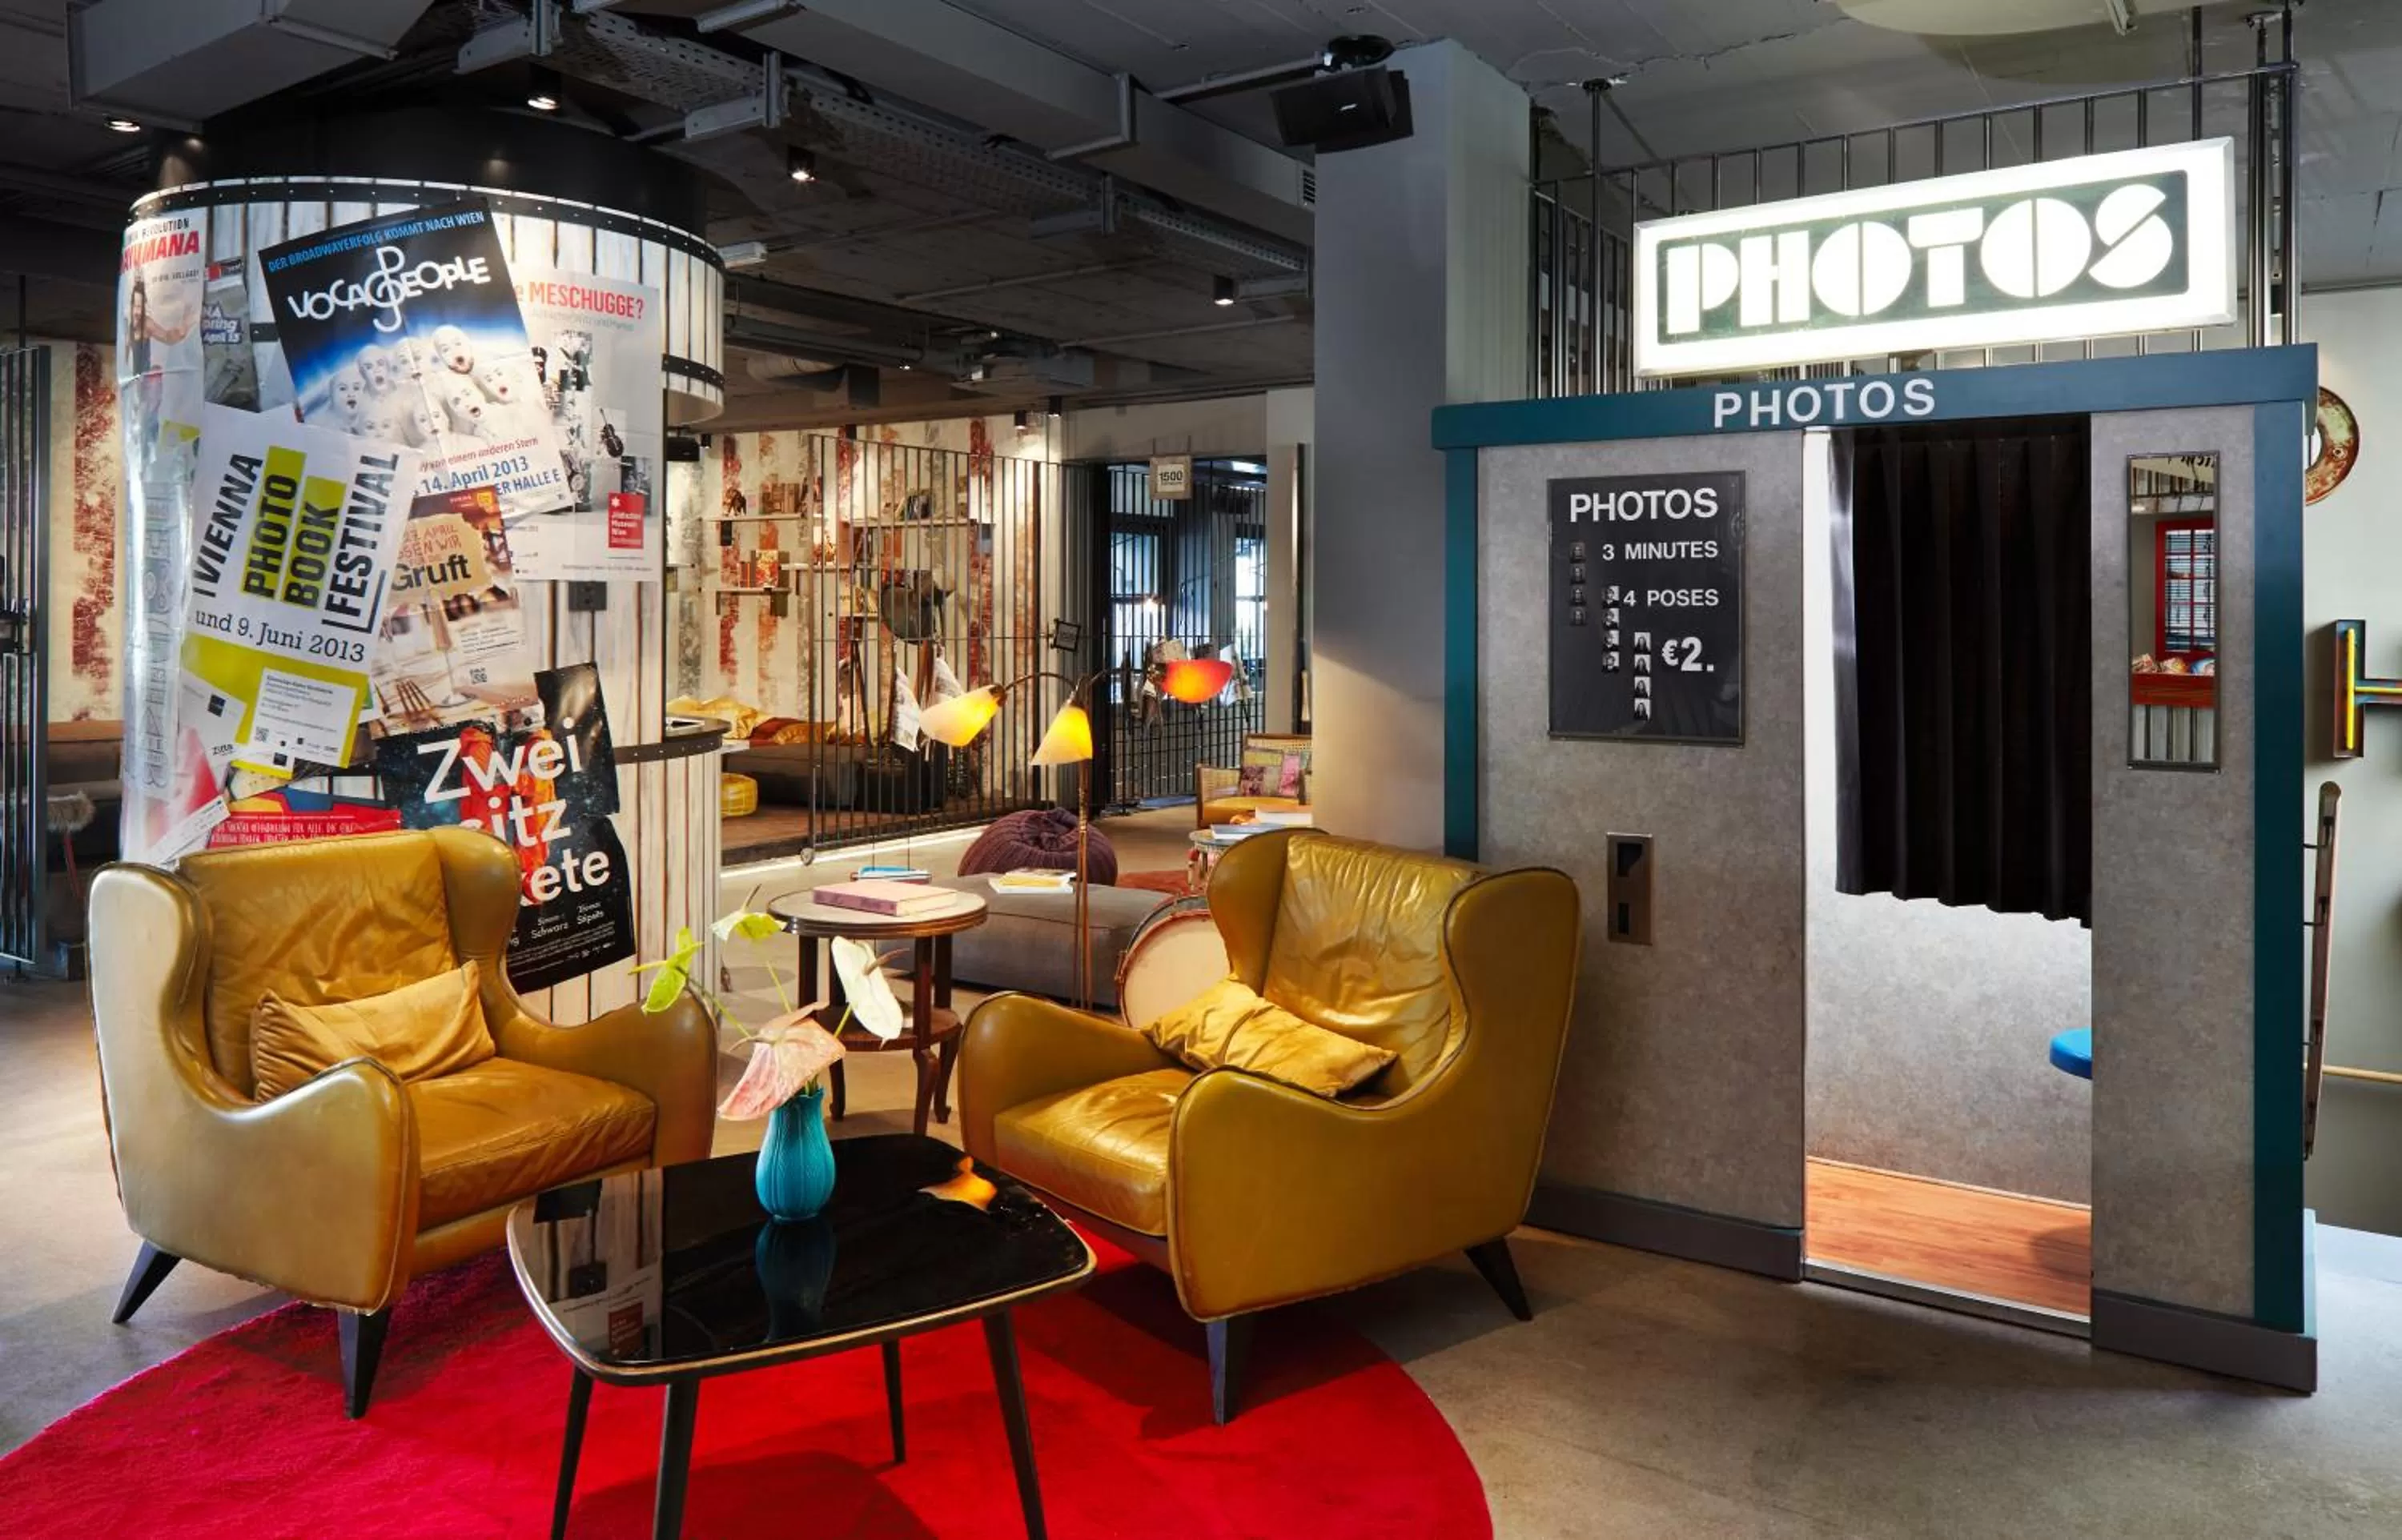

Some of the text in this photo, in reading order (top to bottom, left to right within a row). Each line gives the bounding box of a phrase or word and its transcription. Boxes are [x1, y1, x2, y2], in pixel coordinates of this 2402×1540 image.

[268, 256, 288, 272] DER
[384, 221, 424, 240] KOMMT
[426, 213, 455, 233] NACH
[456, 211, 485, 228] WIEN
[1666, 183, 2173, 335] PHOTOS
[528, 281, 645, 319] MESCHUGGE?
[1713, 378, 1936, 429] PHOTOS
[420, 475, 448, 494] 14.
[452, 463, 488, 488] April
[492, 455, 529, 478] 2013
[514, 471, 549, 491] HALLE
[553, 468, 561, 481] E
[1159, 470, 1183, 481] 1500
[193, 453, 263, 590] VIENNA
[1569, 487, 1720, 523] PHOTOS
[243, 473, 298, 599] PHOTO
[284, 500, 340, 609] BOOK
[324, 452, 400, 617] FESTIVAL
[1602, 540, 1719, 561] 3 MINUTES
[392, 554, 472, 592] Gruft
[1623, 588, 1720, 608] 4 POSES
[195, 610, 365, 663] und 9. Juni 2013
[1661, 636, 1715, 673] €2.
[416, 716, 583, 804] Zwei
